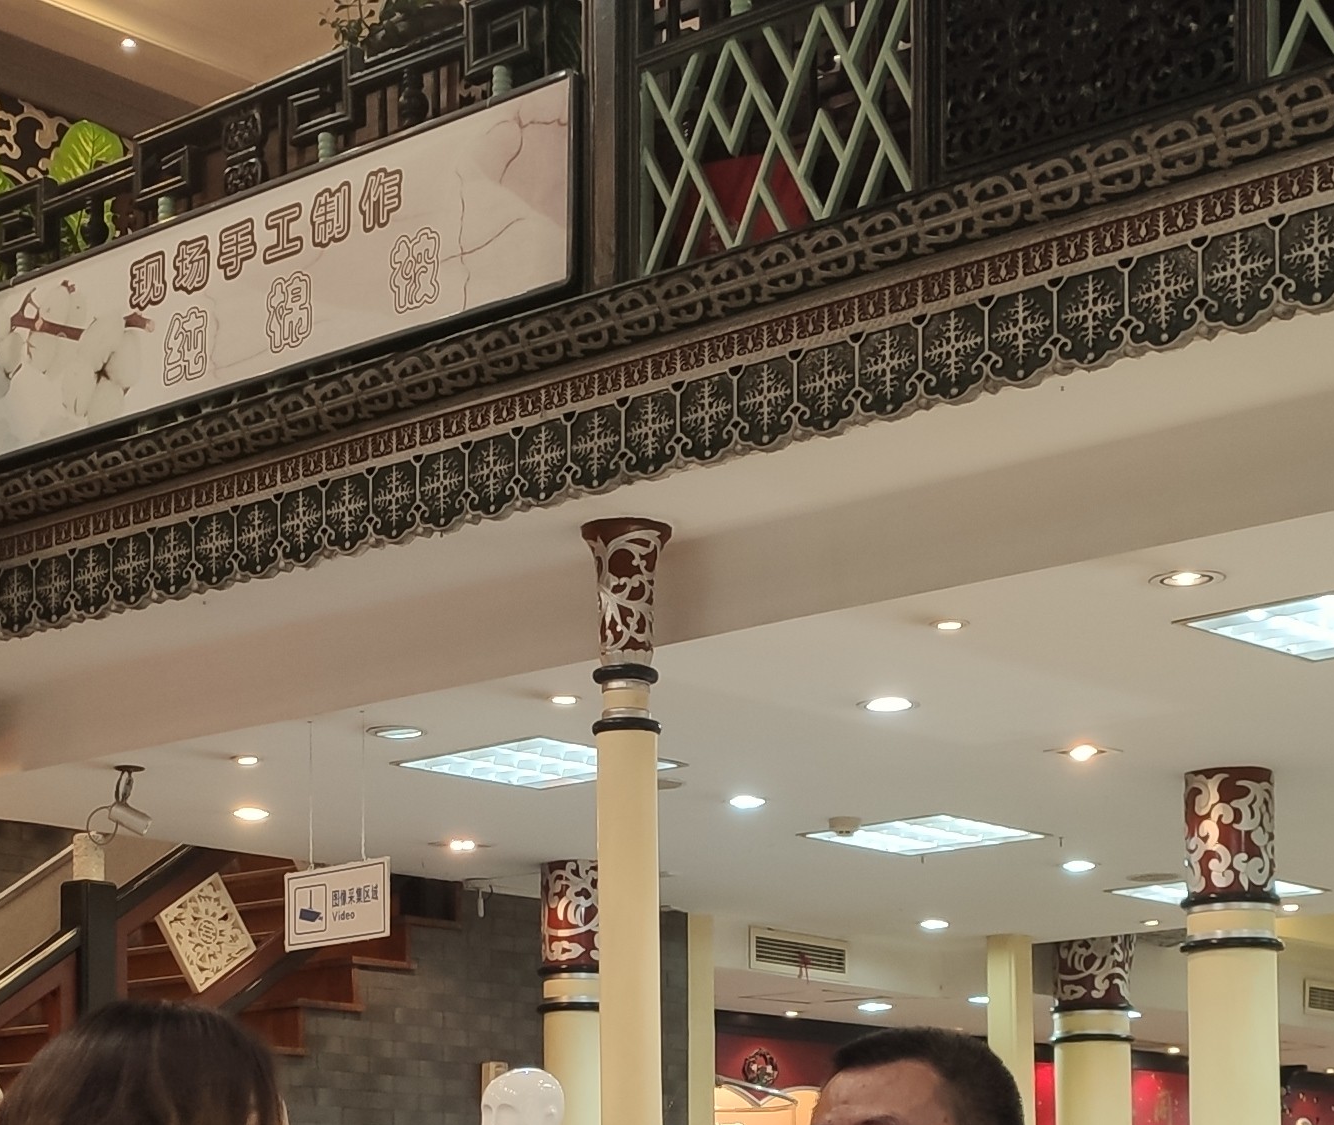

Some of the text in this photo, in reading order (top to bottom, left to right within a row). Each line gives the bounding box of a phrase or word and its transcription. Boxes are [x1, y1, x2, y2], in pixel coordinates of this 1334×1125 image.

[130, 167, 403, 310] 现场手工制作
[331, 910, 356, 922] Video
